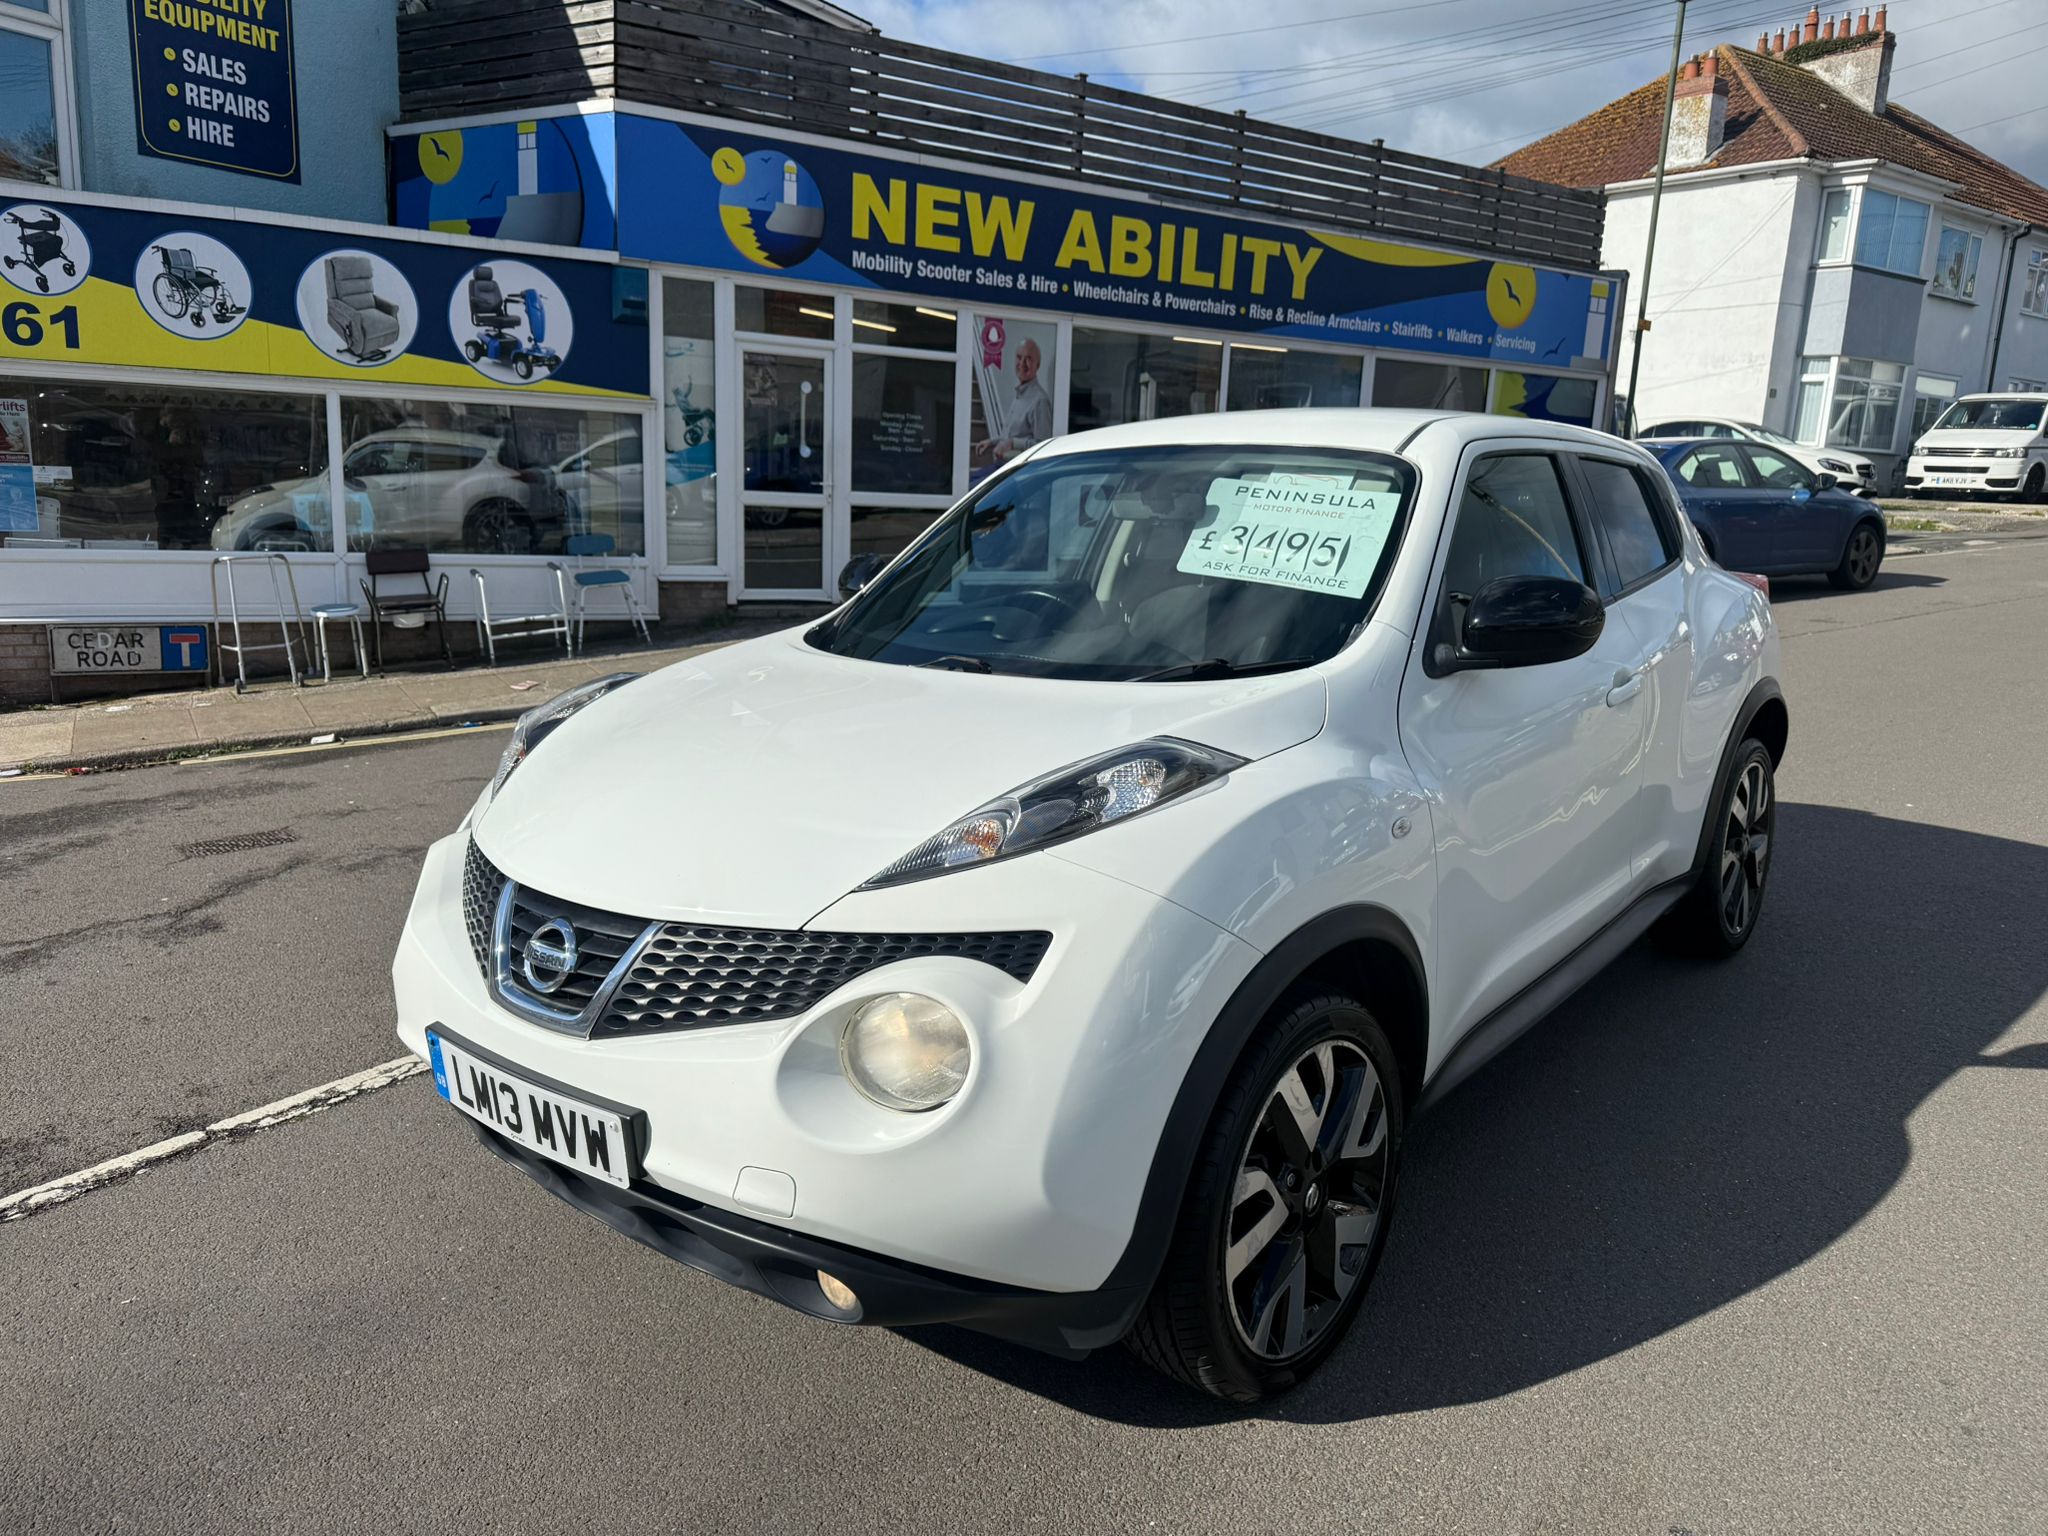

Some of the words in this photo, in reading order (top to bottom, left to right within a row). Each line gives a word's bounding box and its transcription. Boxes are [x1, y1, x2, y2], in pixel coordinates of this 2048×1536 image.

[144, 0, 279, 52] EQUIPMENT
[182, 48, 247, 85] SALES
[184, 81, 271, 123] REPAIRS
[186, 116, 235, 148] HIRE
[852, 172, 1036, 262] NEW
[1054, 208, 1324, 300] ABILITY
[852, 250, 913, 279] Mobility
[917, 259, 972, 283] Scooter
[976, 267, 1013, 289] Sales
[1017, 273, 1027, 290] &
[1031, 275, 1058, 294] Hire
[1073, 280, 1149, 306] Wheelchairs
[1152, 291, 1162, 307] &
[1165, 293, 1236, 317] Powerchairs
[1249, 304, 1273, 321] Rise
[1275, 309, 1284, 322] &
[1287, 308, 1326, 327] Recline
[1327, 314, 1381, 333] Armchairs
[1392, 321, 1433, 340] Stairlifts
[1446, 327, 1483, 345] Walkers
[1495, 334, 1536, 353] Servicing
[2, 301, 80, 349] 61
[1235, 486, 1376, 510] PENINSULA
[1253, 503, 1292, 513] MOTOR
[1295, 507, 1345, 519] FINANCE
[1202, 560, 1233, 572] ASK
[1238, 565, 1272, 577] FOR
[1275, 571, 1349, 590] FINANCE
[68, 632, 145, 649] CEDAR
[77, 651, 142, 667] ROAD
[451, 1054, 523, 1134] LM13
[528, 1094, 611, 1173] MVW
